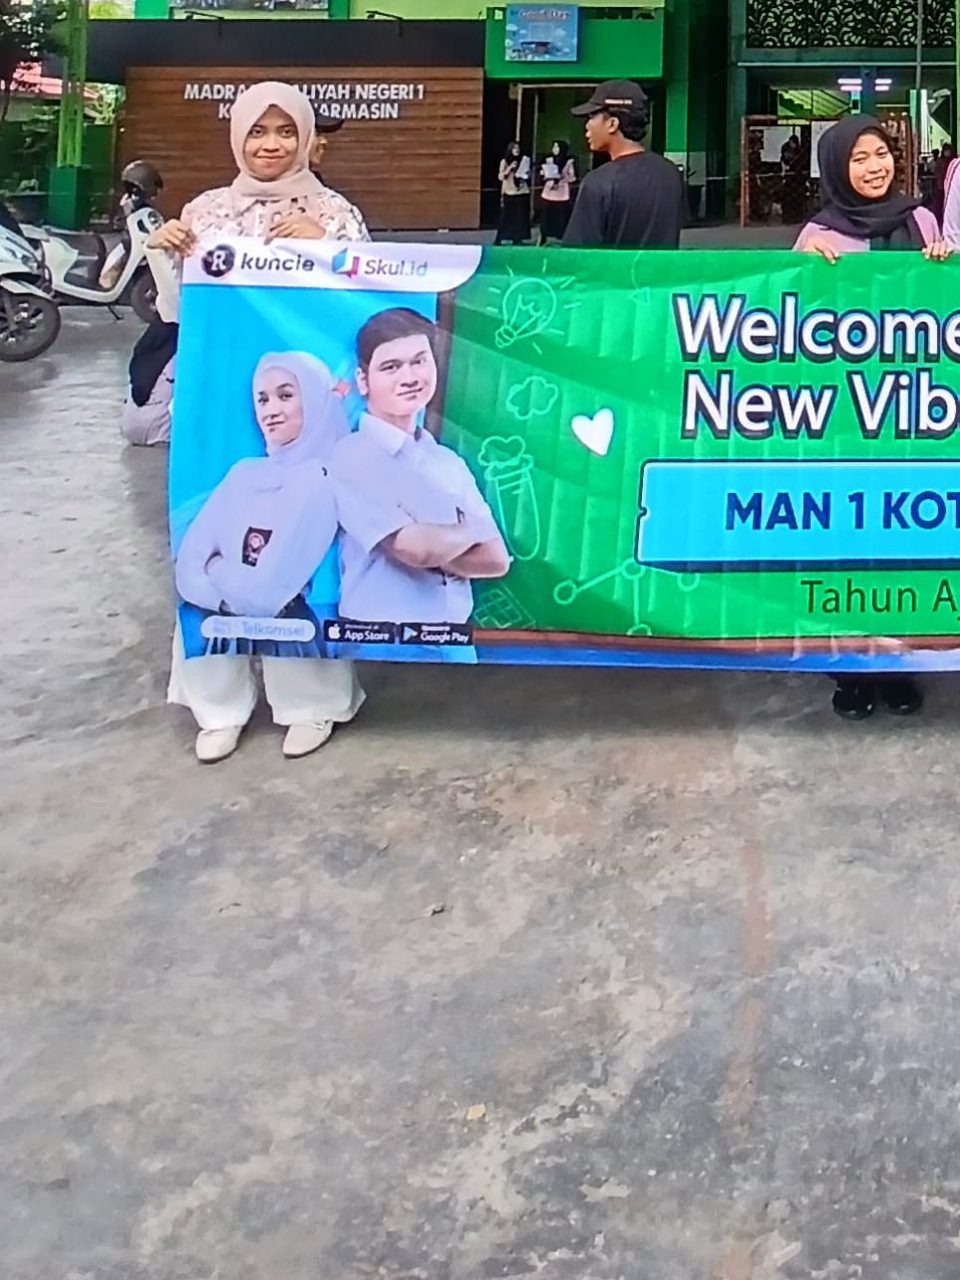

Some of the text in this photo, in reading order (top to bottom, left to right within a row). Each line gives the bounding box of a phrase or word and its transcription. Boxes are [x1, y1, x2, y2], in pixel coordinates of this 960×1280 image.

[184, 84, 424, 100] MADRA LIYAH NEGERI 1
[314, 103, 398, 119] ARMASIN
[241, 253, 315, 272] kuncie
[364, 259, 428, 277] Skul.id
[682, 371, 834, 439] New
[724, 491, 831, 531] MAN
[847, 493, 864, 530] 1
[801, 579, 917, 613] Tahun
[344, 631, 390, 641] App Store
